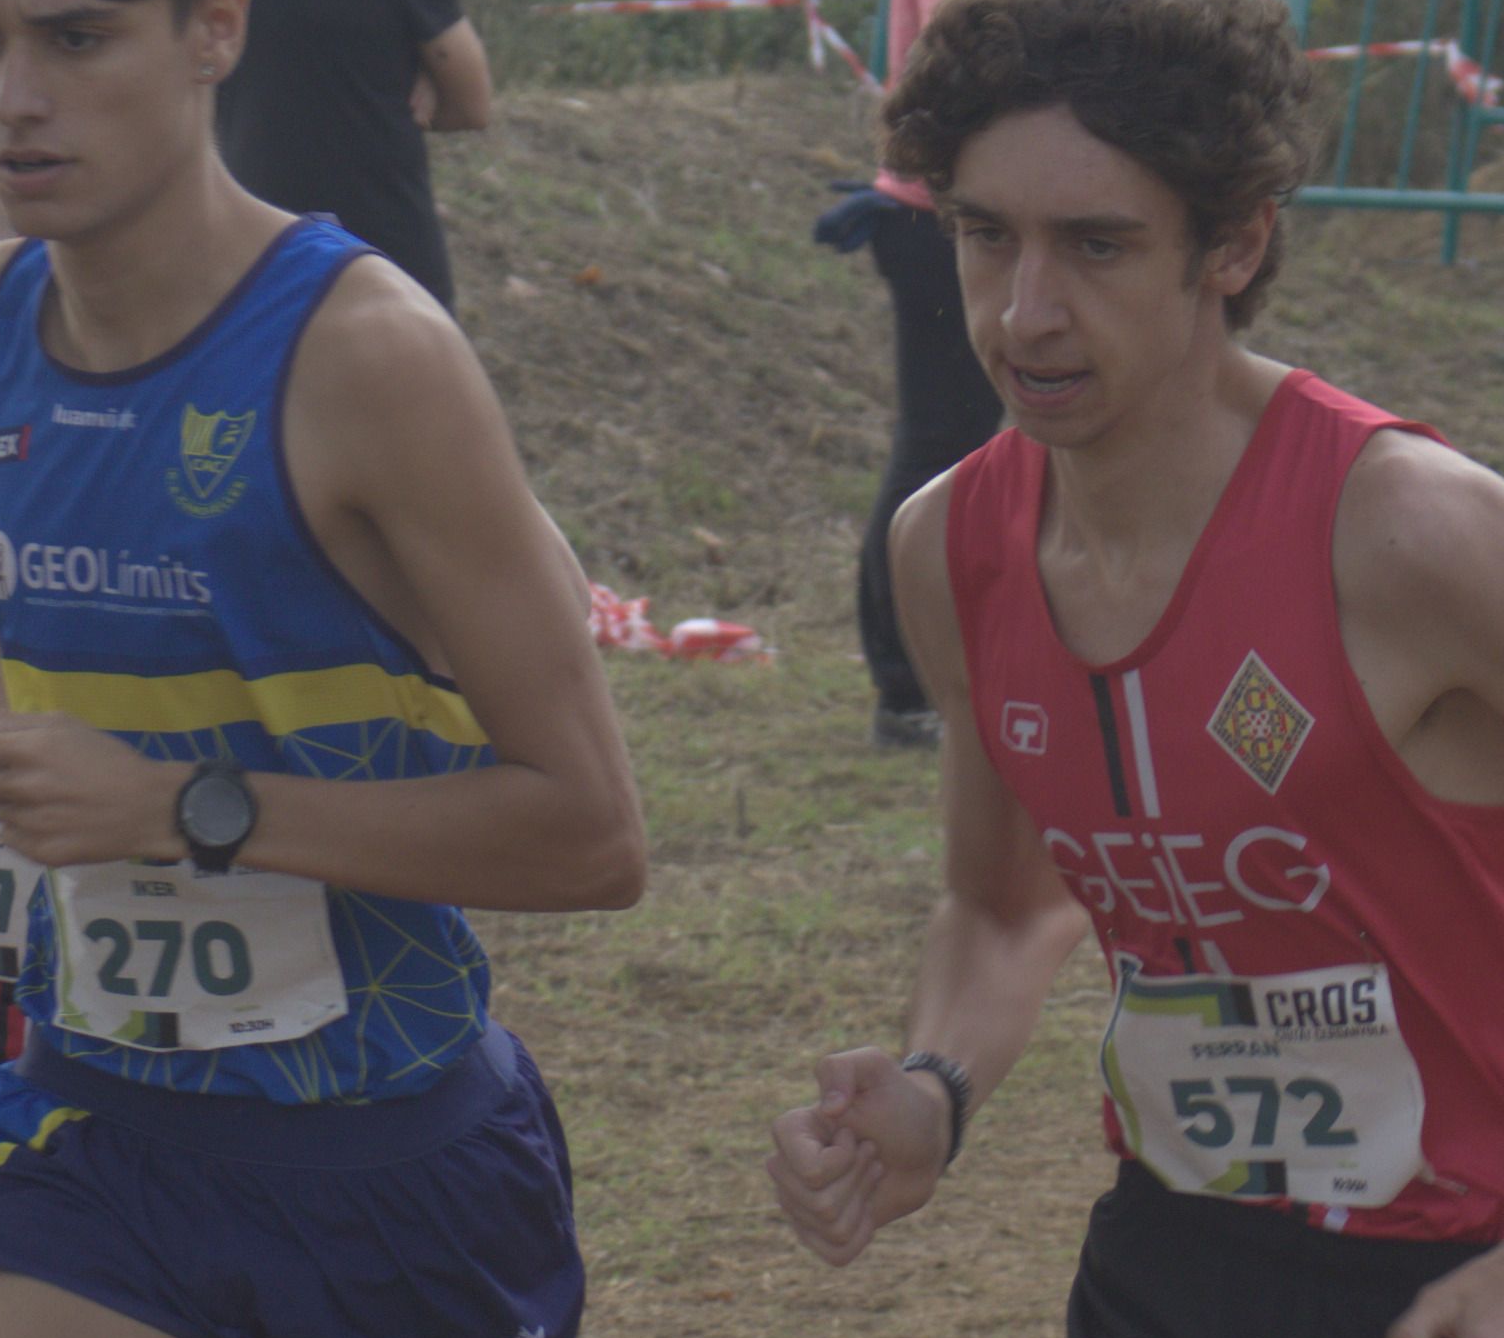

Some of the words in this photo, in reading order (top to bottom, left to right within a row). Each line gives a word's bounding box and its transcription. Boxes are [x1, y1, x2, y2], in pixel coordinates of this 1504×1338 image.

[132, 880, 177, 897] IKER
[84, 919, 254, 997] 270
[1266, 977, 1376, 1028] CROS
[1192, 1040, 1281, 1060] FERRAN
[1170, 1077, 1360, 1147] 572
